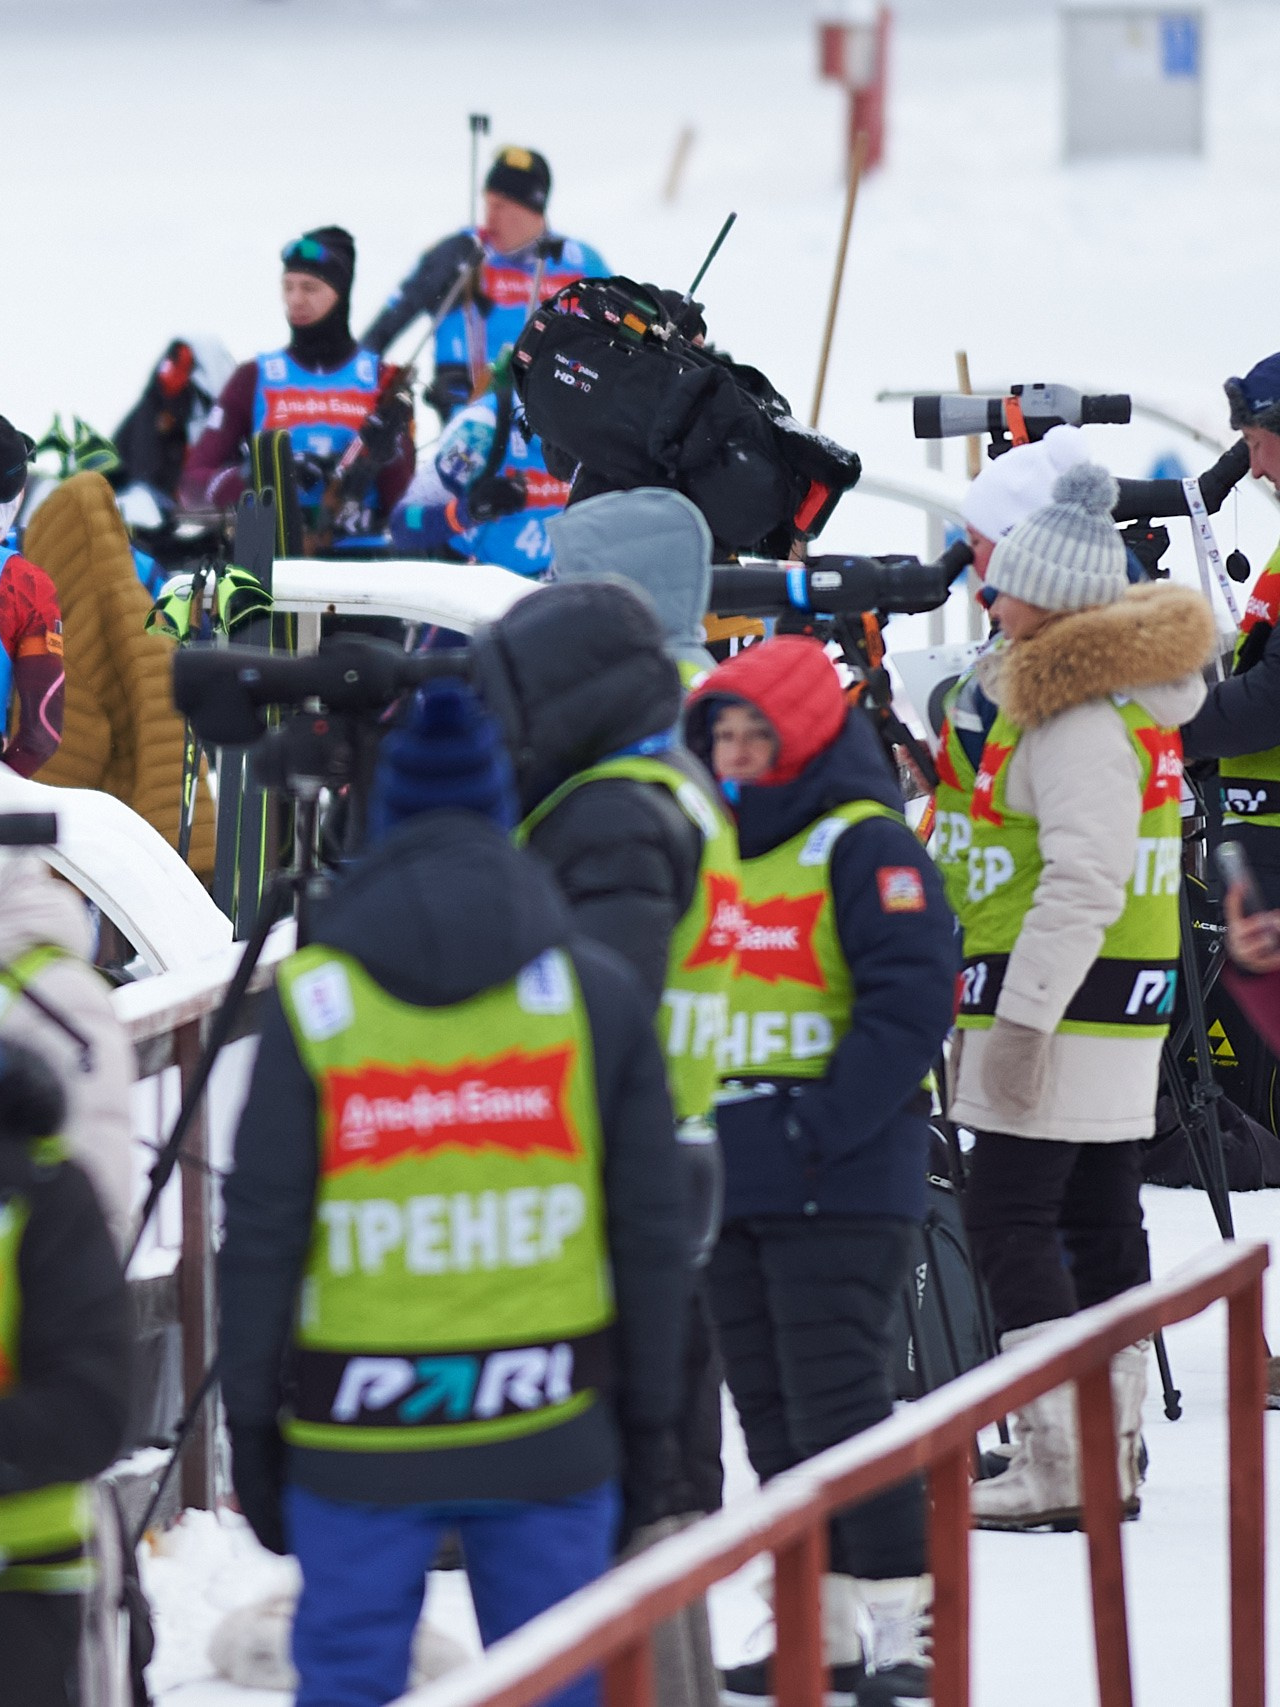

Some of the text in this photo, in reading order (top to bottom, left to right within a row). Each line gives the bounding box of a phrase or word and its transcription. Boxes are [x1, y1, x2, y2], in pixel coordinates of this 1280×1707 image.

[276, 398, 368, 417] Альфа Банк
[342, 1080, 552, 1136] Альфа Банк
[319, 1182, 585, 1276] ТРЕНЕР
[331, 1343, 573, 1421] PARI
